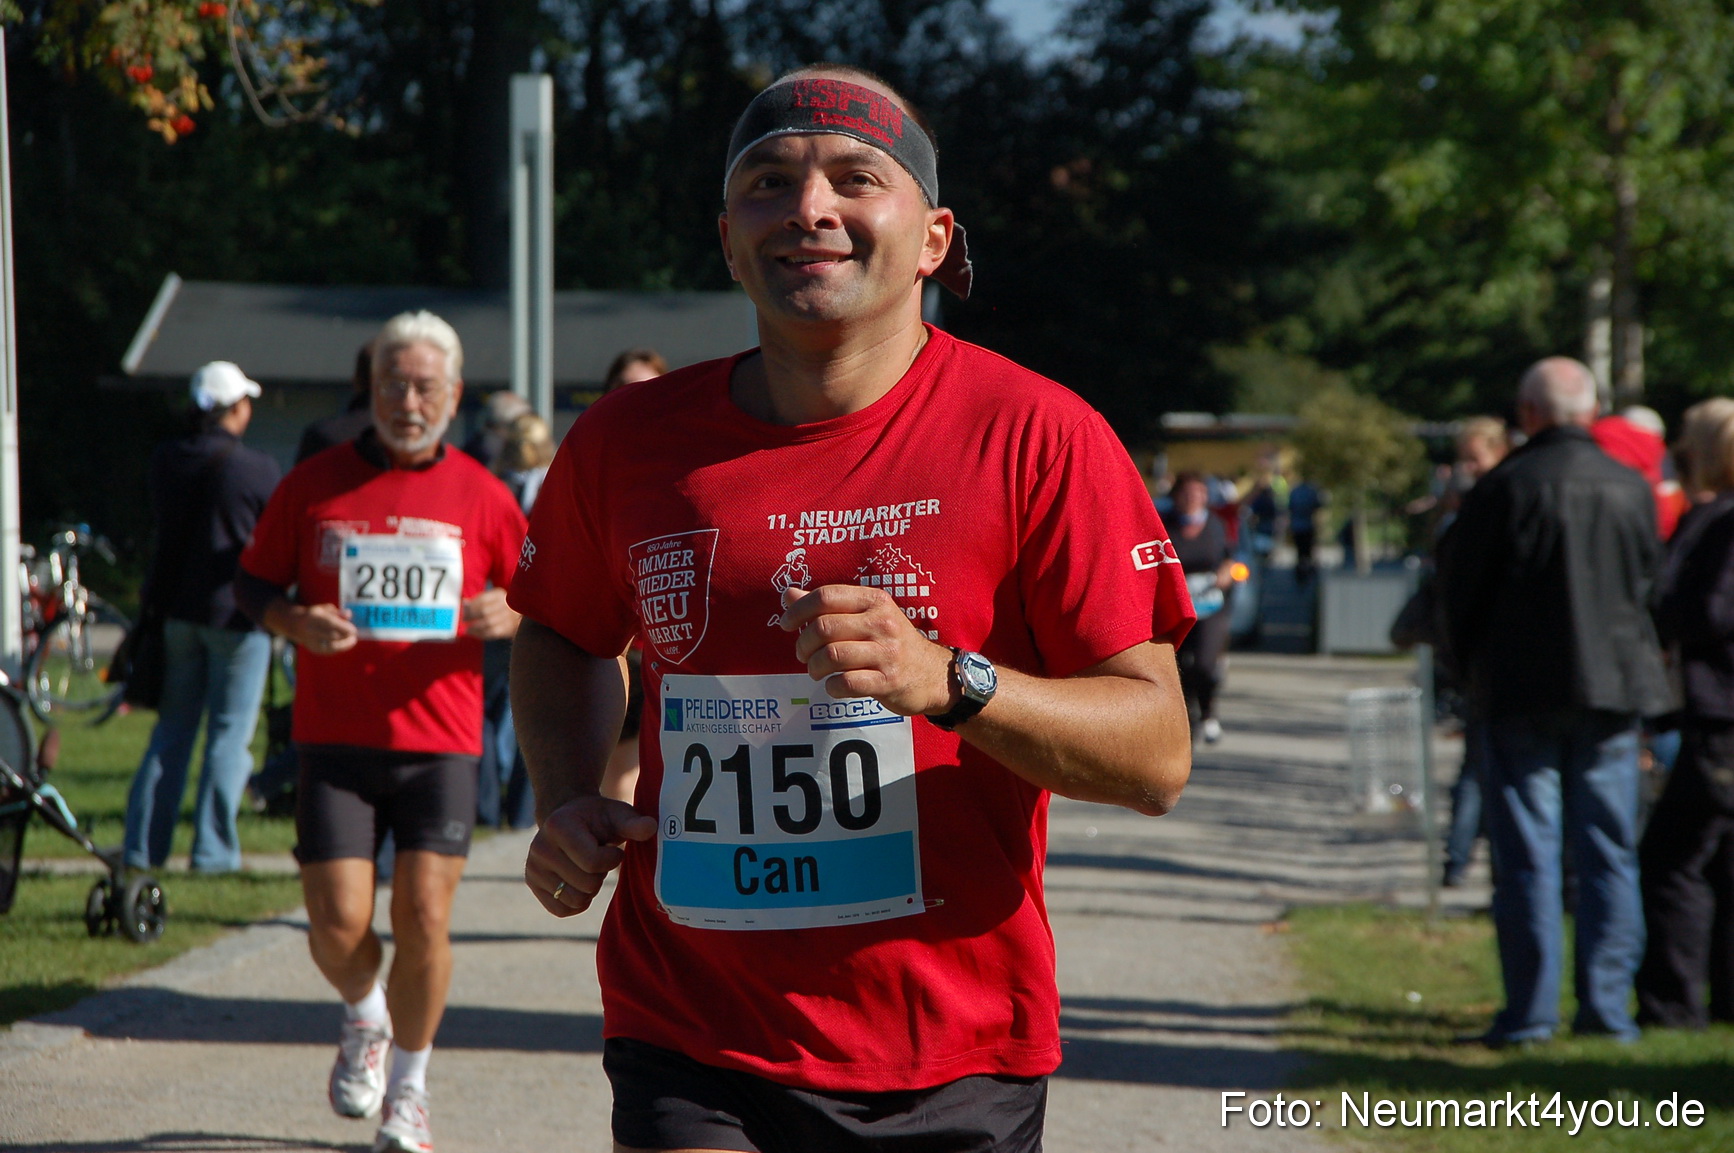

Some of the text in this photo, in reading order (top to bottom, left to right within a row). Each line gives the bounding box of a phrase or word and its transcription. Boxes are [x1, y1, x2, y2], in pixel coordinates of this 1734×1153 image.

[767, 499, 941, 530] 11. NEUMARKTER
[792, 519, 911, 546] STADTLAUF
[646, 540, 682, 553] 850 Jahre
[638, 549, 695, 577] IMMER
[356, 563, 447, 601] 2807
[638, 570, 696, 597] WIEDER
[641, 591, 690, 625] NEU
[648, 622, 693, 644] MARKT
[686, 698, 781, 720] PFLEIDERER
[809, 697, 883, 721] BOCK
[686, 723, 781, 734] AKTIENGESELLSCHAFT
[682, 738, 882, 835] 2150
[733, 846, 820, 896] Can
